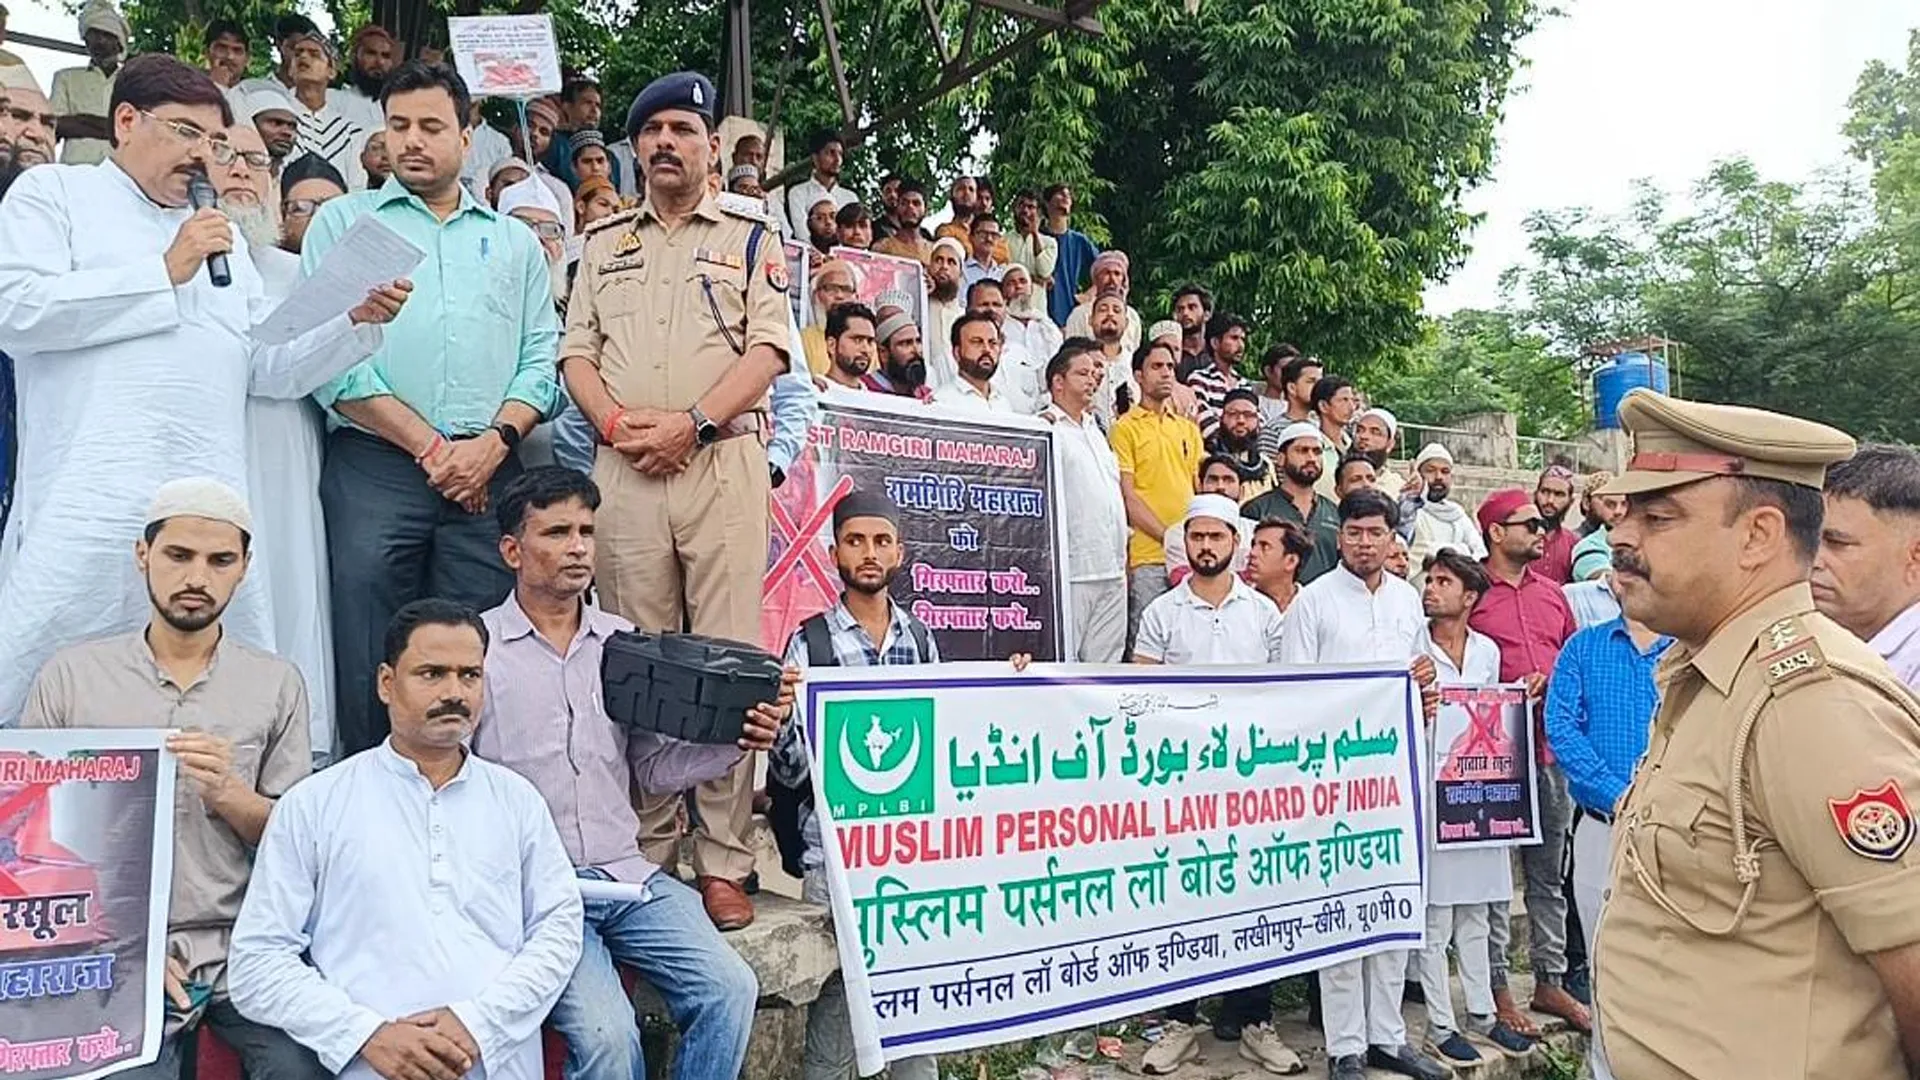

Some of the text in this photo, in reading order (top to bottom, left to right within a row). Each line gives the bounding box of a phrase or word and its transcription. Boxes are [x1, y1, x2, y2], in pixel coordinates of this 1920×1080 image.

[840, 427, 932, 459] RAMGIRI
[937, 440, 1037, 469] MAHARAJ
[969, 484, 1042, 517] महाराज
[948, 522, 978, 551] को
[33, 755, 141, 784] MAHARAJ
[949, 723, 1041, 801] انڈیا
[1052, 716, 1113, 780] آف
[1121, 718, 1188, 786] بورڈ
[1236, 723, 1326, 777] پرسنل
[1333, 717, 1398, 772] مسلم
[836, 776, 1401, 869] MUSLIM PERSONAL LAW BOARD OF INDIA
[998, 856, 1116, 927] पर्सनल
[1124, 845, 1170, 909] लॉ
[1178, 833, 1238, 897] बोर्ड
[1249, 832, 1310, 885] ऑफ
[1317, 821, 1403, 887] इण्डिया
[930, 968, 1014, 1009] पर्सनल
[1023, 957, 1053, 995] लॉ
[1059, 946, 1099, 987] बोर्ड
[1108, 941, 1150, 977] ऑफ
